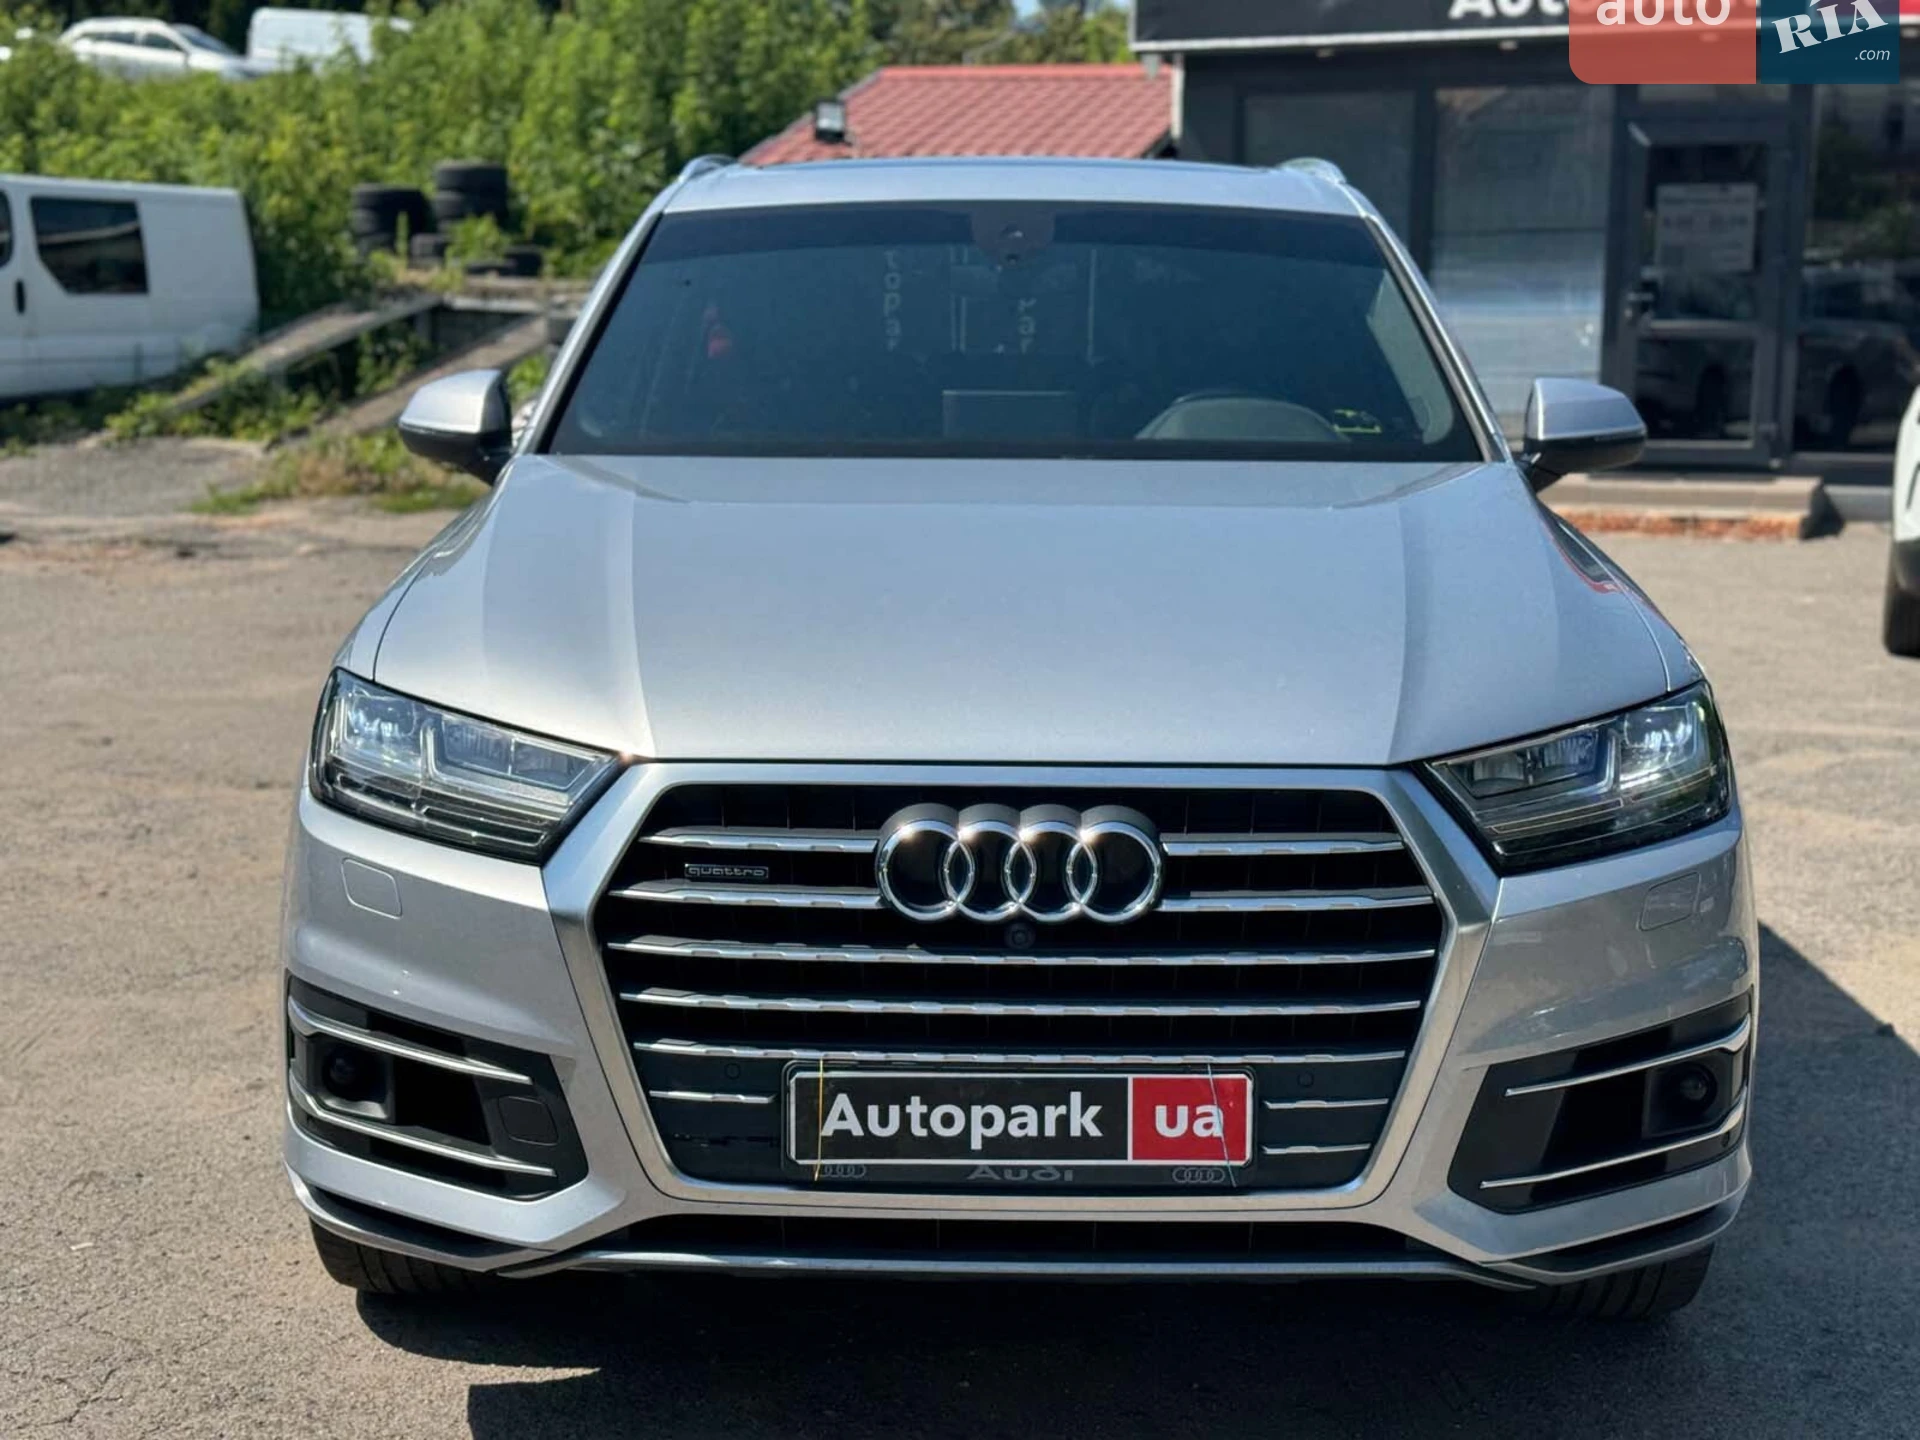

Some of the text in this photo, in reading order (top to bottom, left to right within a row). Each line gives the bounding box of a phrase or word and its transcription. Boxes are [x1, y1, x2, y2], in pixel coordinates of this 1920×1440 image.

[688, 867, 765, 877] quattro
[821, 1091, 1224, 1150] Autopark ua
[966, 1163, 1074, 1182] Audi
